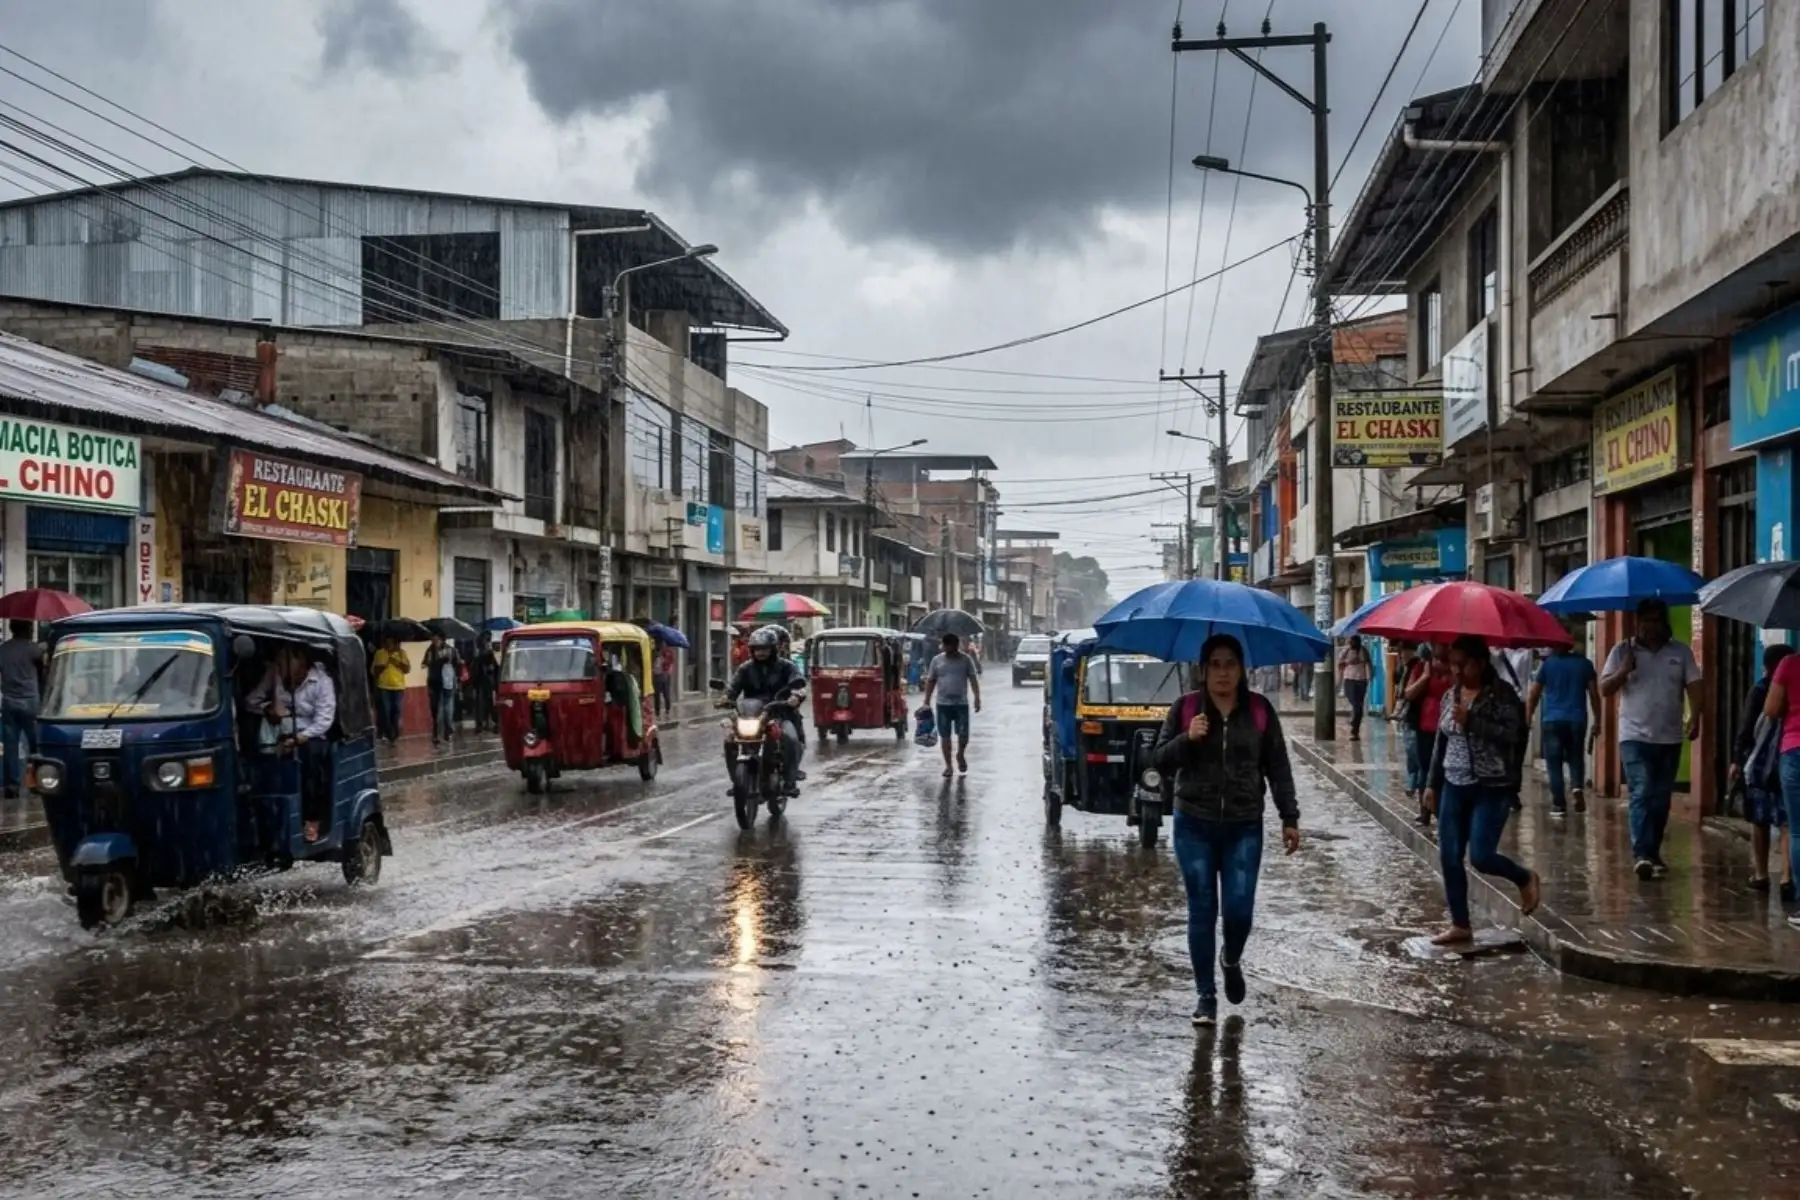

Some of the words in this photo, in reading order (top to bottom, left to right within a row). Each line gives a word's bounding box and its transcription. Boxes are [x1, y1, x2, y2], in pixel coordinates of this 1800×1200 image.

[1337, 421, 1360, 440] EL
[1365, 419, 1441, 439] CHASKI
[67, 431, 137, 469] BOTICA
[19, 459, 114, 500] CHINO
[242, 483, 271, 518] EL
[275, 490, 349, 530] CHASKI
